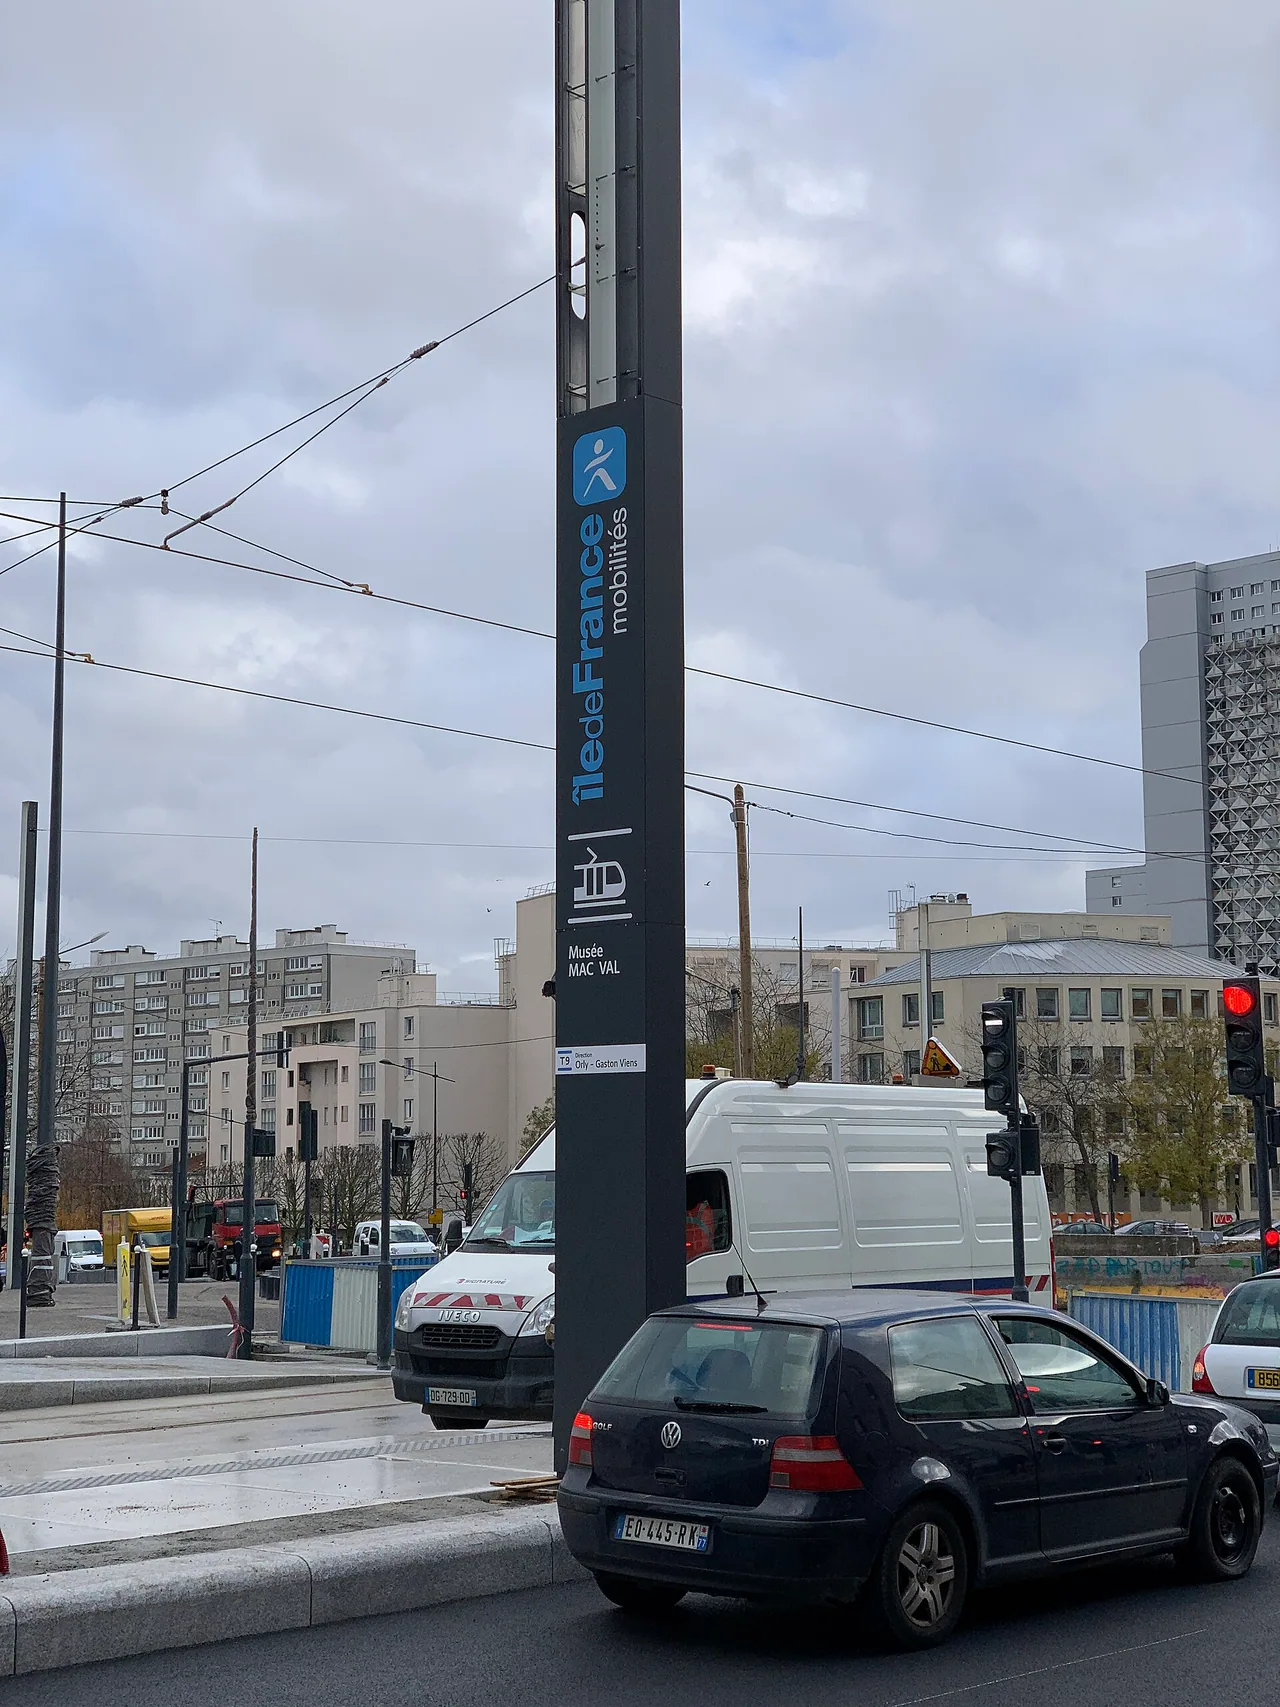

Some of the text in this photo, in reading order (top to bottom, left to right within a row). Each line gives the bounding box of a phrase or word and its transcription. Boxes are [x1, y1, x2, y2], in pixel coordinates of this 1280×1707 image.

[607, 506, 628, 634] mobilités
[568, 943, 604, 960] Musée
[568, 960, 621, 977] MAC VAL
[559, 1056, 570, 1066] T9
[575, 1060, 589, 1070] Orly
[595, 1059, 619, 1069] Gaston
[619, 1058, 638, 1068] Viens
[1067, 1215, 1119, 1228] Lle
[438, 1310, 481, 1323] IVECO
[592, 1422, 613, 1431] GOLF
[751, 1438, 770, 1447] TDI
[697, 1538, 707, 1548] 77
